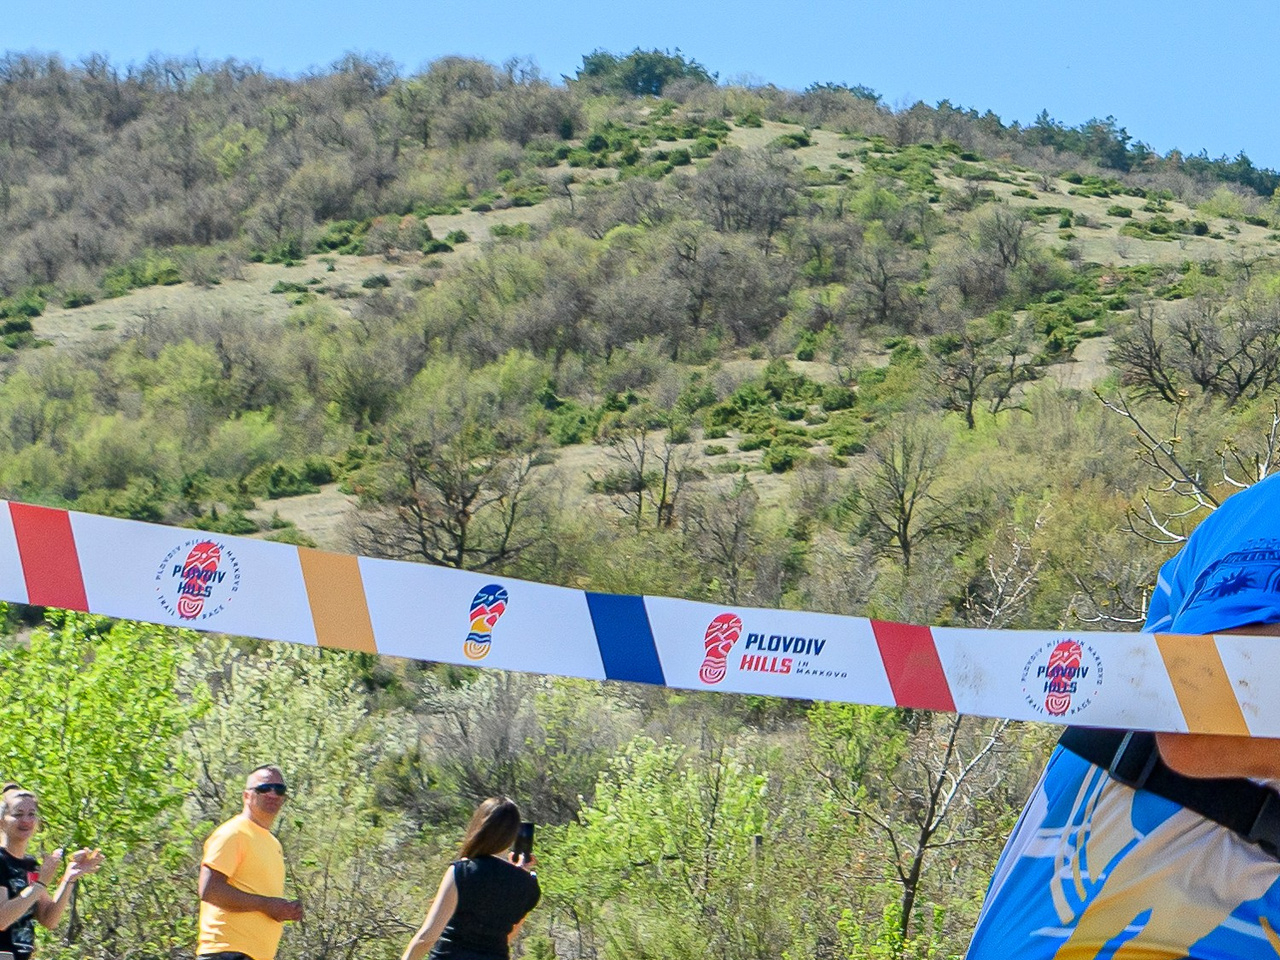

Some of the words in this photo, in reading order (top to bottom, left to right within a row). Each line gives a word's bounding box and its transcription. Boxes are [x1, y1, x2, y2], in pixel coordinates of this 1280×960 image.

[172, 564, 226, 584] PLOVDIV
[177, 582, 213, 598] HILLS
[745, 632, 827, 656] PLOVDIV
[739, 654, 793, 675] HILLS
[1037, 665, 1089, 679] PLOVDIV
[1043, 681, 1078, 694] HILLS
